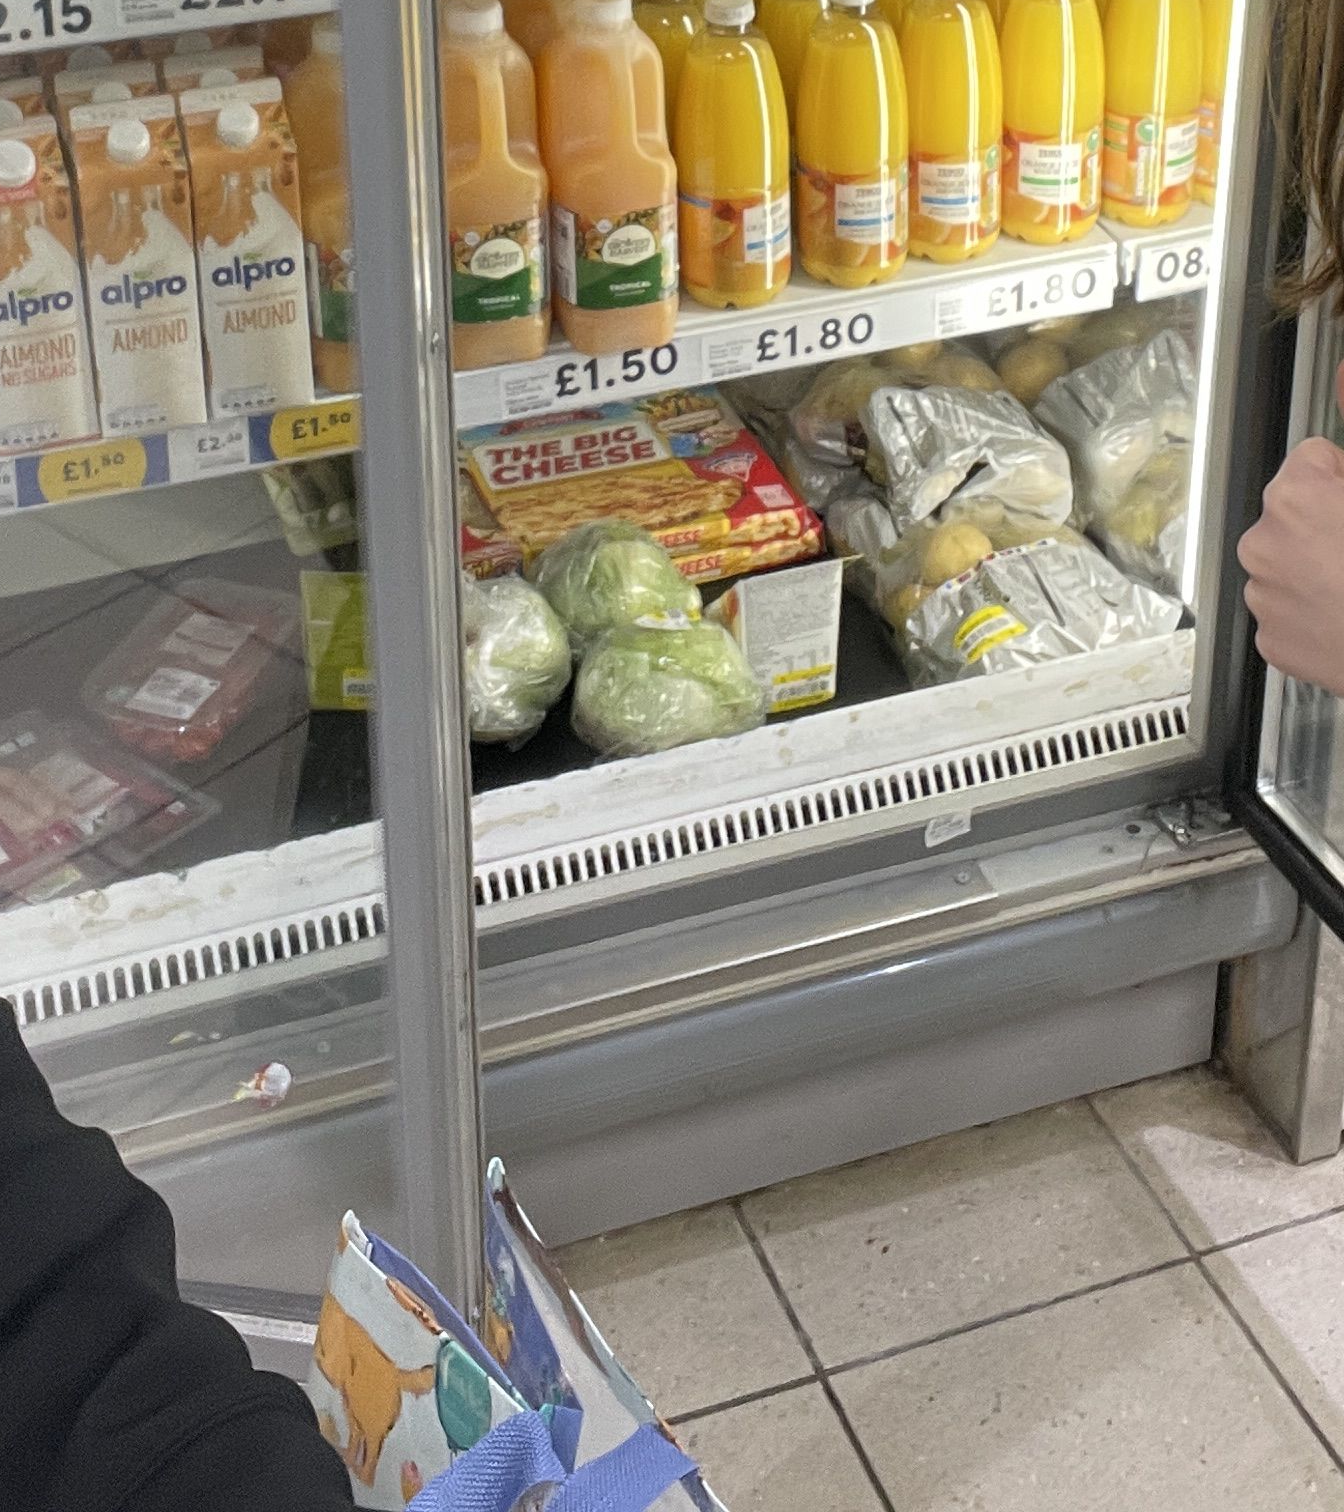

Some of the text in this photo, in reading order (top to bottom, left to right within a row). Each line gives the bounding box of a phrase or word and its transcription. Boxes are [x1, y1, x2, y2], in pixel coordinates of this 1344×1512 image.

[101, 274, 188, 309] alpro
[212, 255, 296, 291] alpro
[986, 266, 1097, 320] £1.80
[112, 318, 189, 353] ALMOND
[222, 299, 297, 335] ALMOND
[0, 334, 76, 370] ALMOND
[755, 312, 875, 363] £1.80
[555, 341, 680, 399] £1.50
[487, 424, 639, 466] THE BIG
[490, 439, 657, 485] CHEESE
